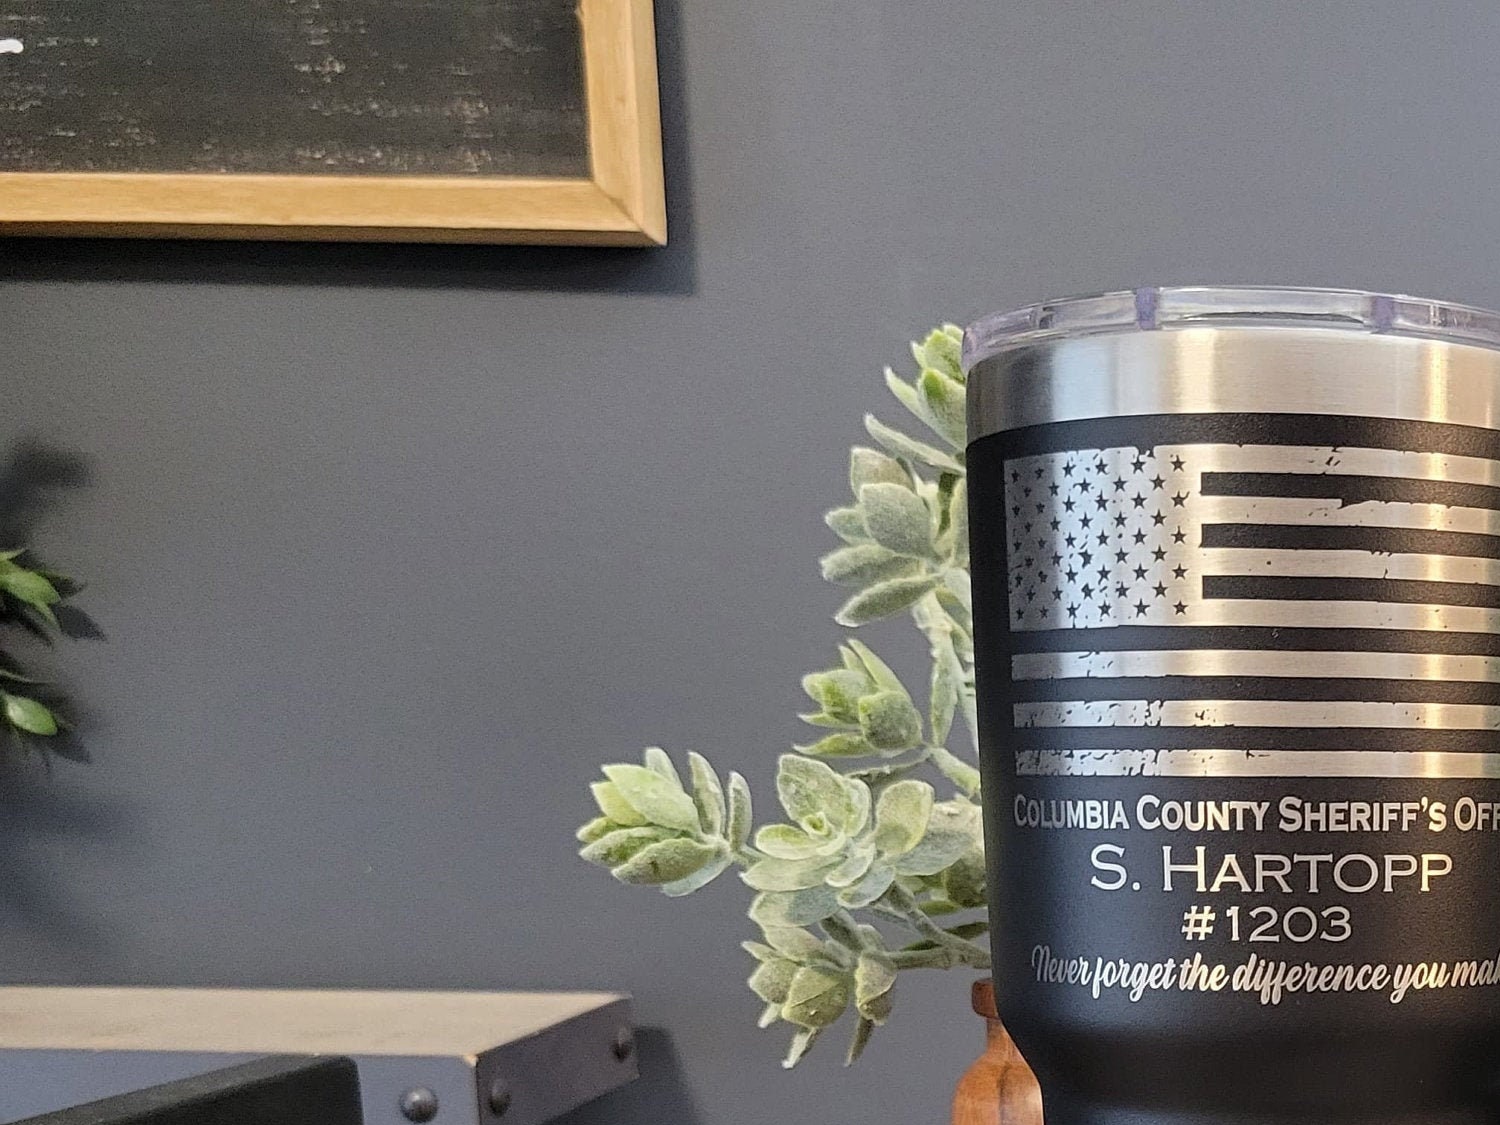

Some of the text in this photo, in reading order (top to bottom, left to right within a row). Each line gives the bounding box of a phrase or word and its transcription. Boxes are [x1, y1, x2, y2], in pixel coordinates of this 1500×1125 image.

[1090, 843, 1141, 890] S.
[1181, 905, 1352, 943] #1203
[1031, 944, 1092, 985] Never
[1091, 957, 1177, 1002] forget
[1178, 952, 1230, 991] the
[1231, 953, 1391, 1005] difference
[1390, 962, 1451, 1004] you
